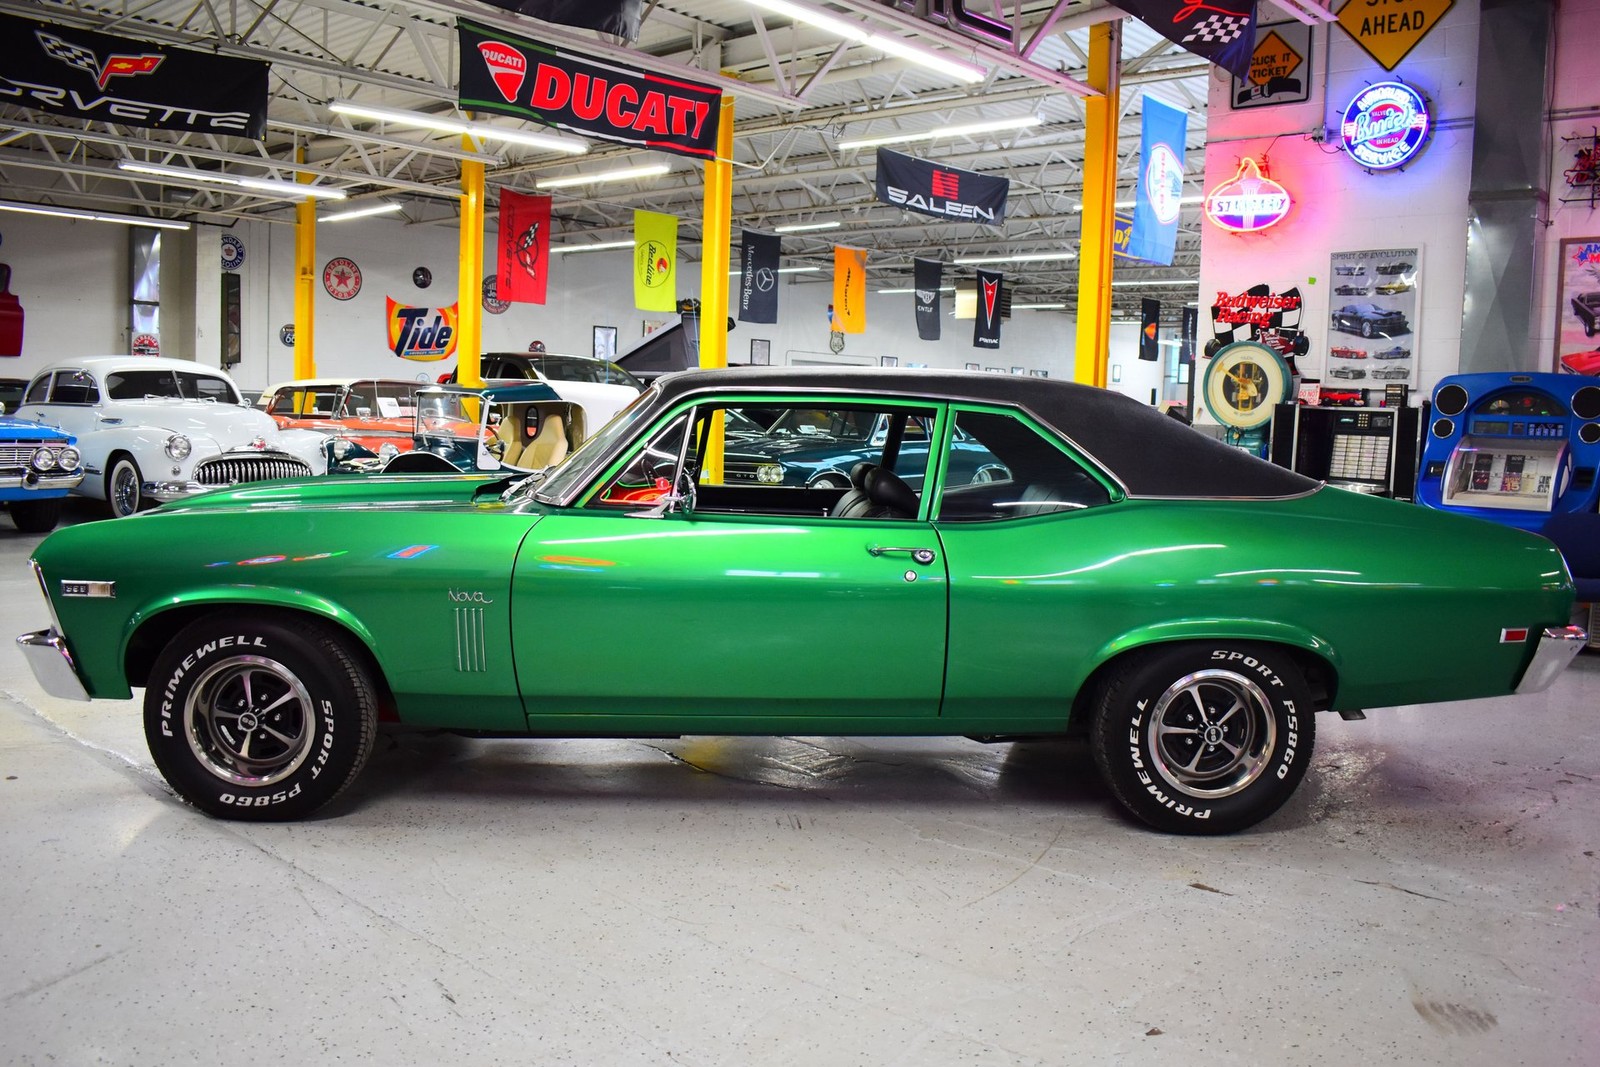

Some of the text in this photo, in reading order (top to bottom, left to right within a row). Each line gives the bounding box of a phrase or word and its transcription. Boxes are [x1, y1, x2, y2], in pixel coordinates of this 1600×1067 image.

[1360, 10, 1424, 37] AHEAD
[482, 48, 523, 68] DUCATI
[1251, 52, 1291, 66] CLICK IT
[1252, 66, 1288, 78] TICKET
[530, 63, 710, 140] DUCATI
[1354, 141, 1410, 164] SERVICE
[887, 186, 994, 220] SALEEN
[506, 204, 515, 289] CORVETTE
[1370, 249, 1417, 259] EVOLUTION
[327, 260, 359, 276] GASOLINE
[646, 243, 657, 285] Beeline
[326, 280, 359, 298] MOTOR OIL
[1213, 291, 1300, 309] Budweiser
[1216, 306, 1274, 328] Racing
[394, 308, 453, 357] Tide
[448, 587, 493, 604] Nova
[161, 635, 267, 737] PRIMEWELL
[1210, 650, 1298, 780] SPORT PS860
[219, 699, 334, 807] SPORT PS860
[1129, 698, 1212, 819] PRIMEWELL
